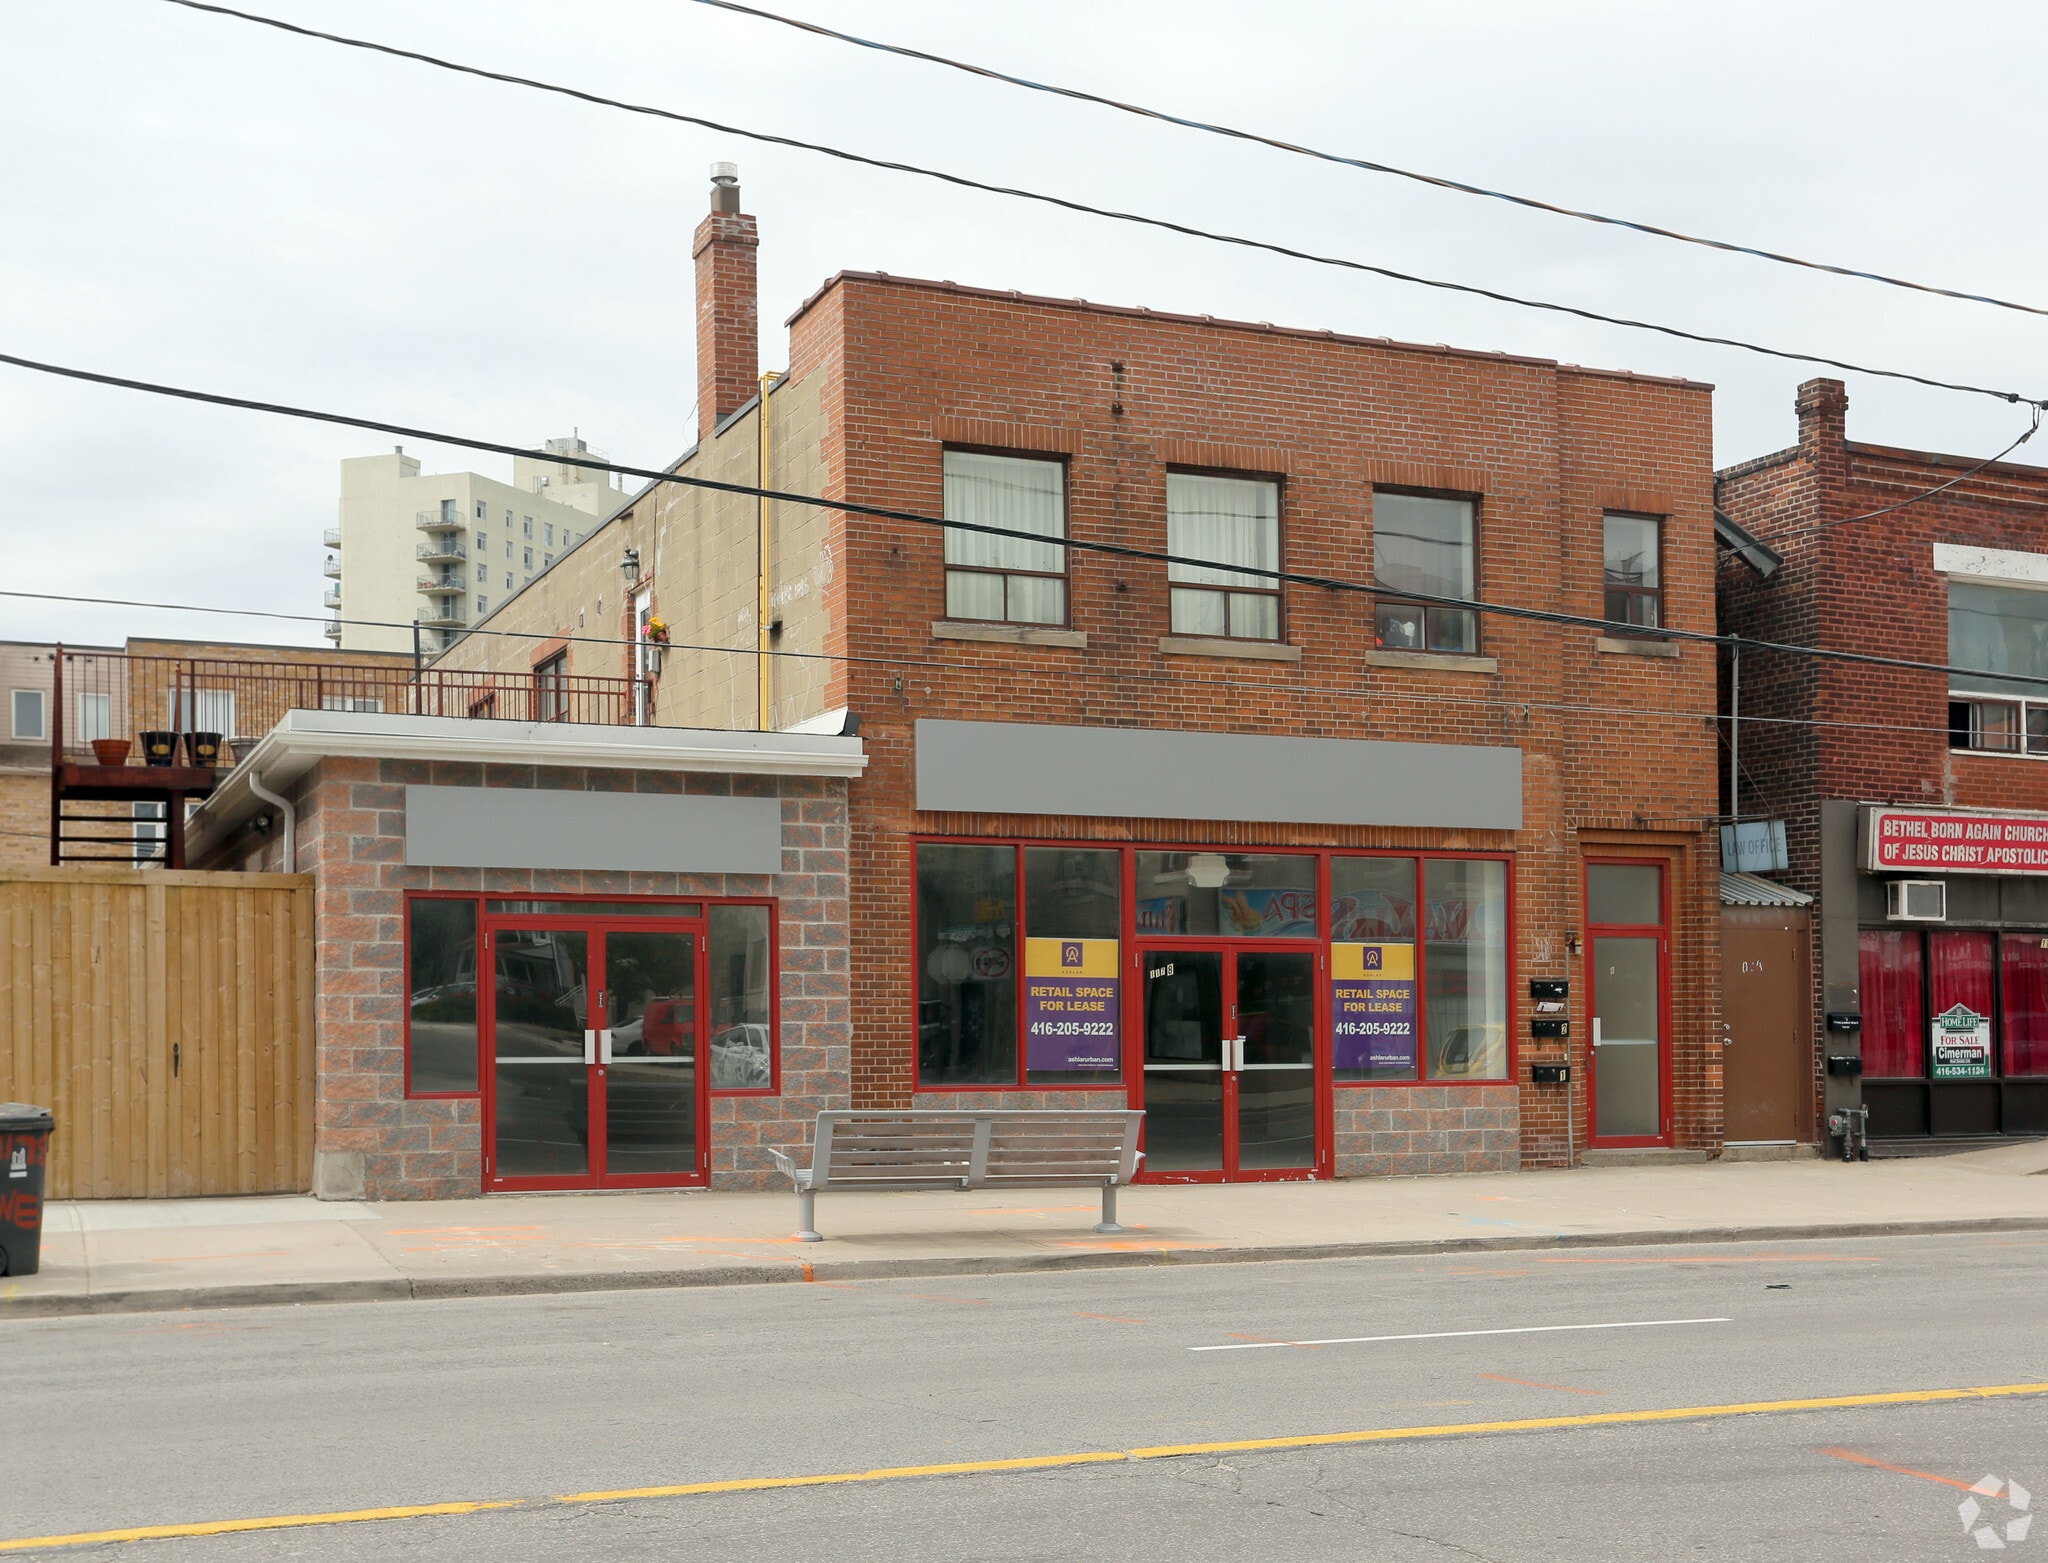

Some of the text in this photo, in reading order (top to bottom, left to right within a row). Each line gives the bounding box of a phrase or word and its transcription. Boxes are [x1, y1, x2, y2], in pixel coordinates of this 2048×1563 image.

[1883, 819, 2048, 842] BETHEL BORN AGAIN CHURCH
[1727, 837, 1782, 856] LAW OFFICE
[1884, 843, 1900, 859] OF
[1902, 844, 1939, 860] JESUS
[1942, 845, 1984, 862] CHRIST
[1030, 986, 1114, 997] RETAIL SPACE
[1335, 989, 1410, 999] RETAIL SPACE
[1040, 1001, 1105, 1012] FOR LEASE
[1344, 1002, 1402, 1012] FOR LEASE
[1030, 1022, 1114, 1036] 416-205-9222
[1335, 1022, 1410, 1035] 416-205-9222
[1940, 1035, 1980, 1045] FOR SALE
[1938, 1047, 1982, 1060] Cimerman
[1936, 1067, 1985, 1076] 416-534-1124
